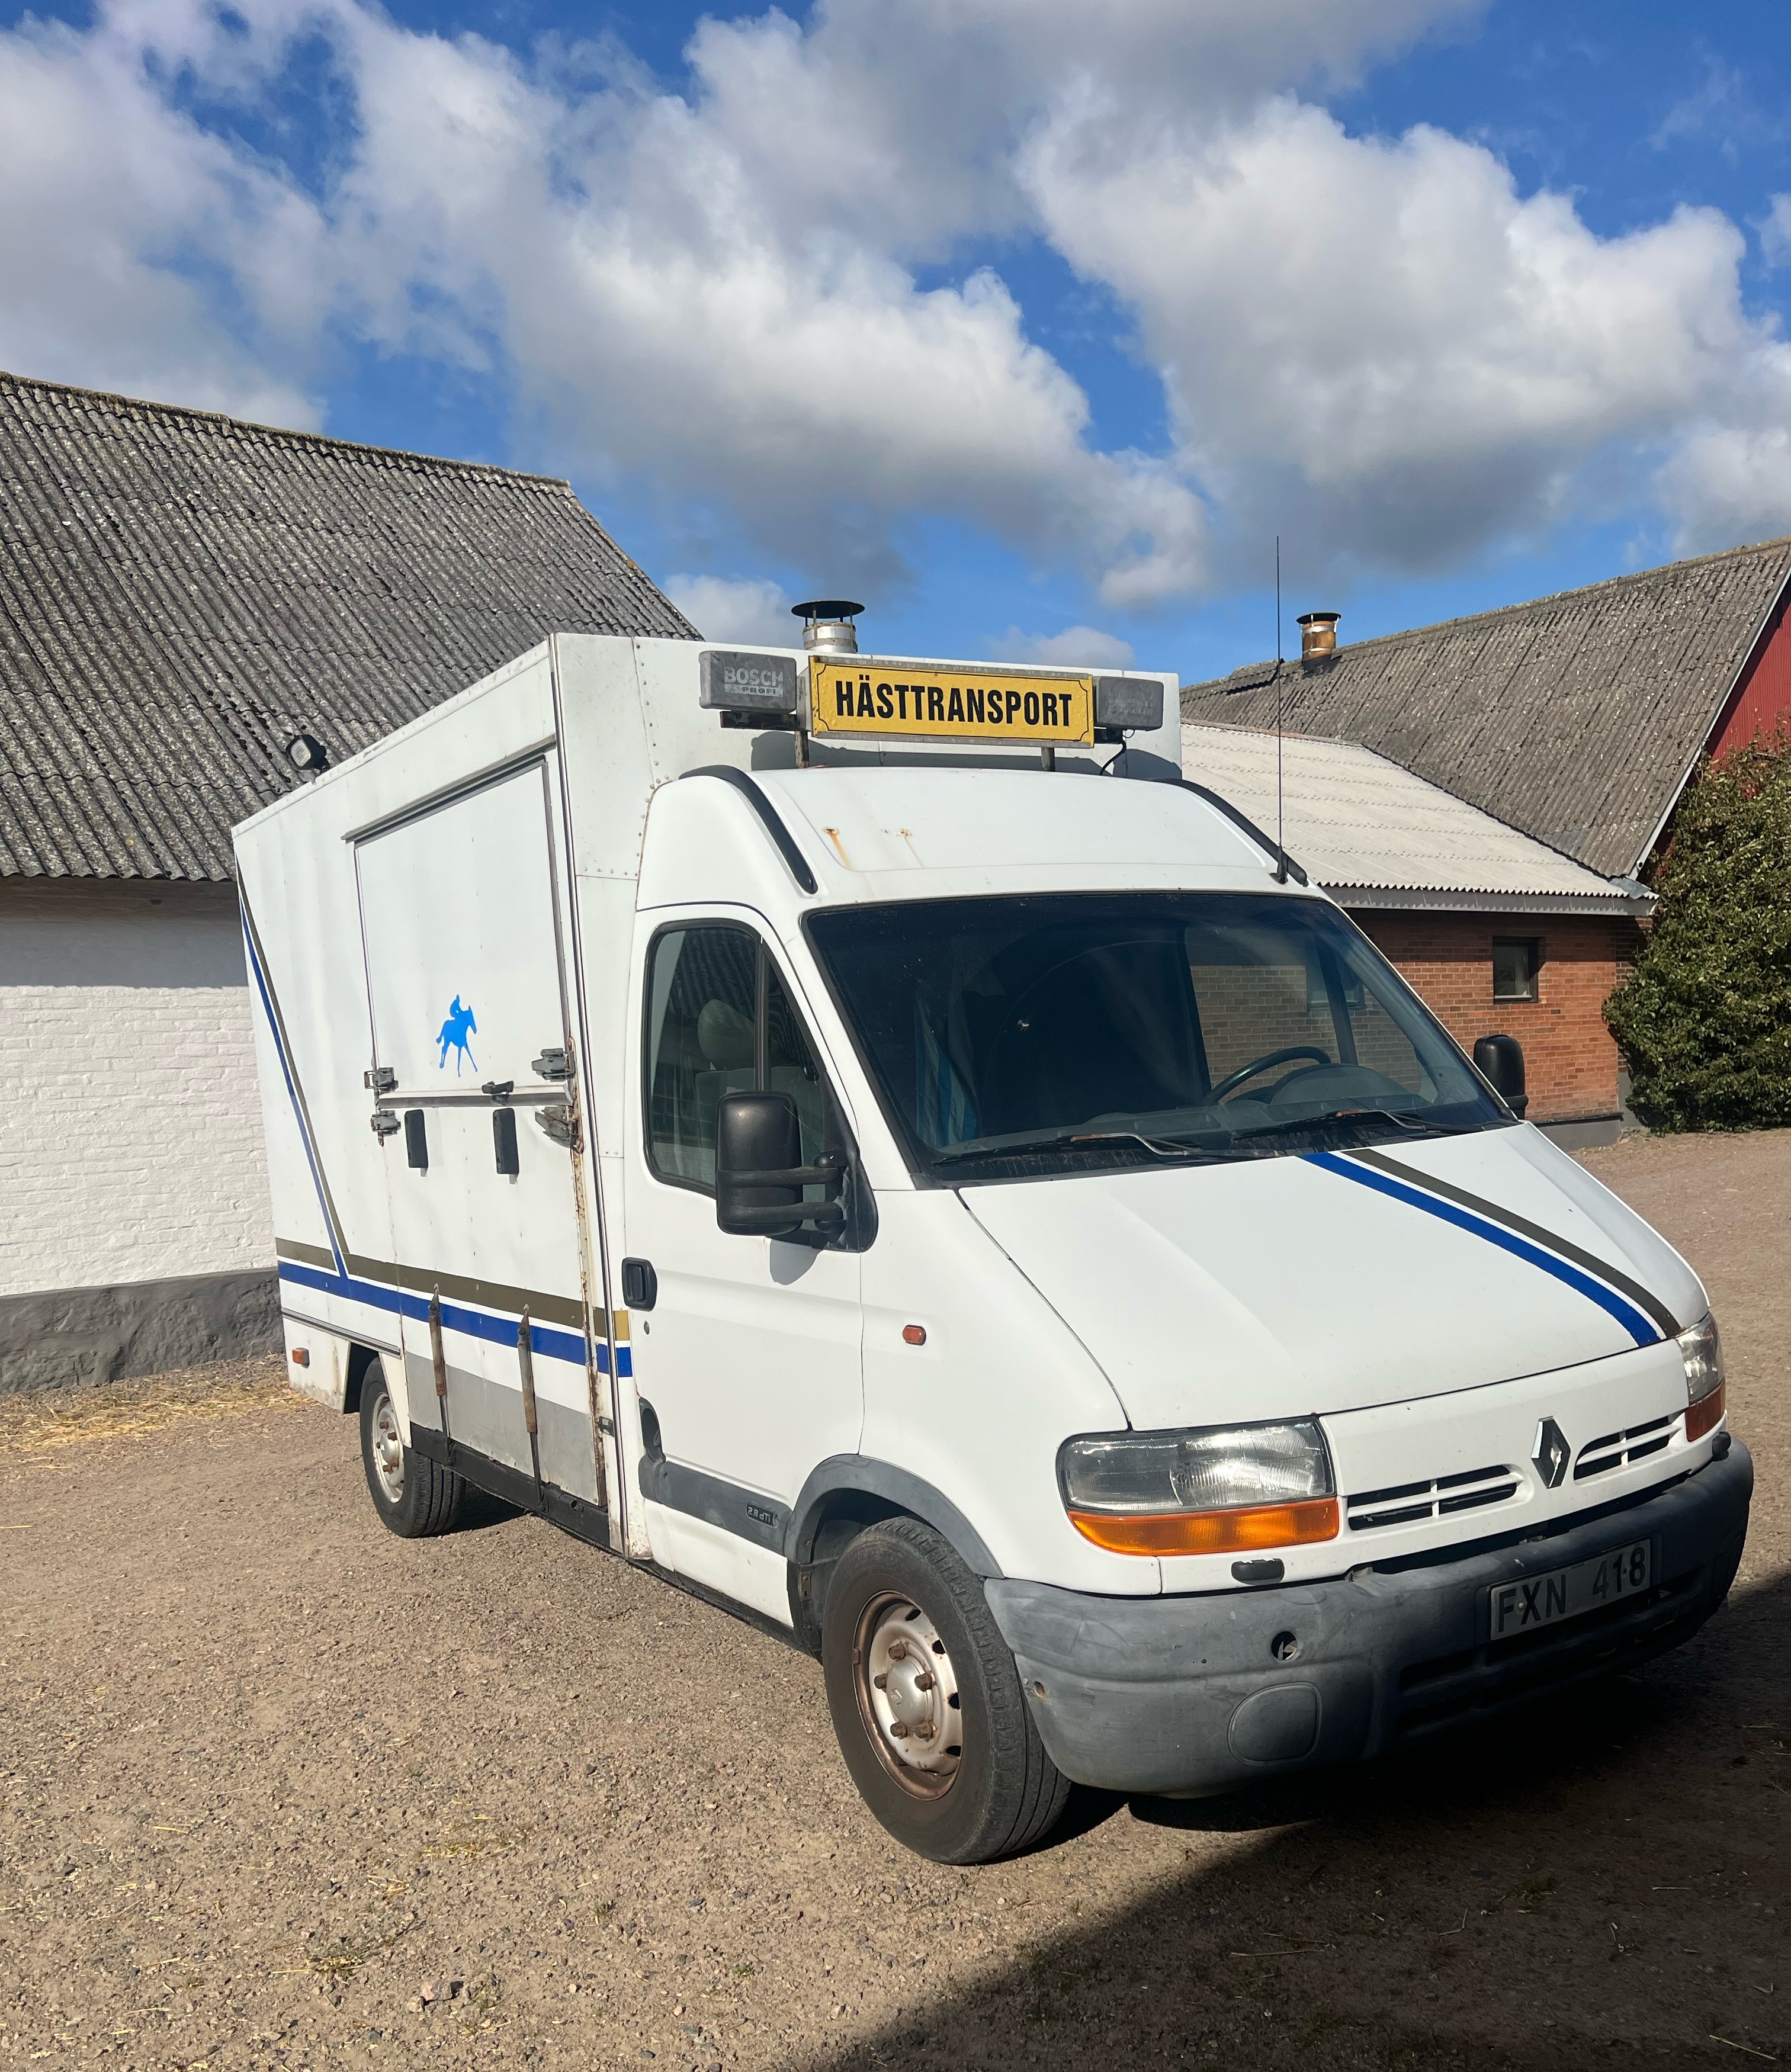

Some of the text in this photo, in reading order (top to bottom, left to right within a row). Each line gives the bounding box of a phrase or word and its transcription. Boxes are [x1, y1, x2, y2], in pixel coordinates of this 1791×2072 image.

[724, 667, 783, 687] BOSCH
[742, 686, 776, 695] PROFI
[836, 674, 1072, 727] HÄSTTRANSPORT
[1498, 1546, 1645, 1633] FXN 418
